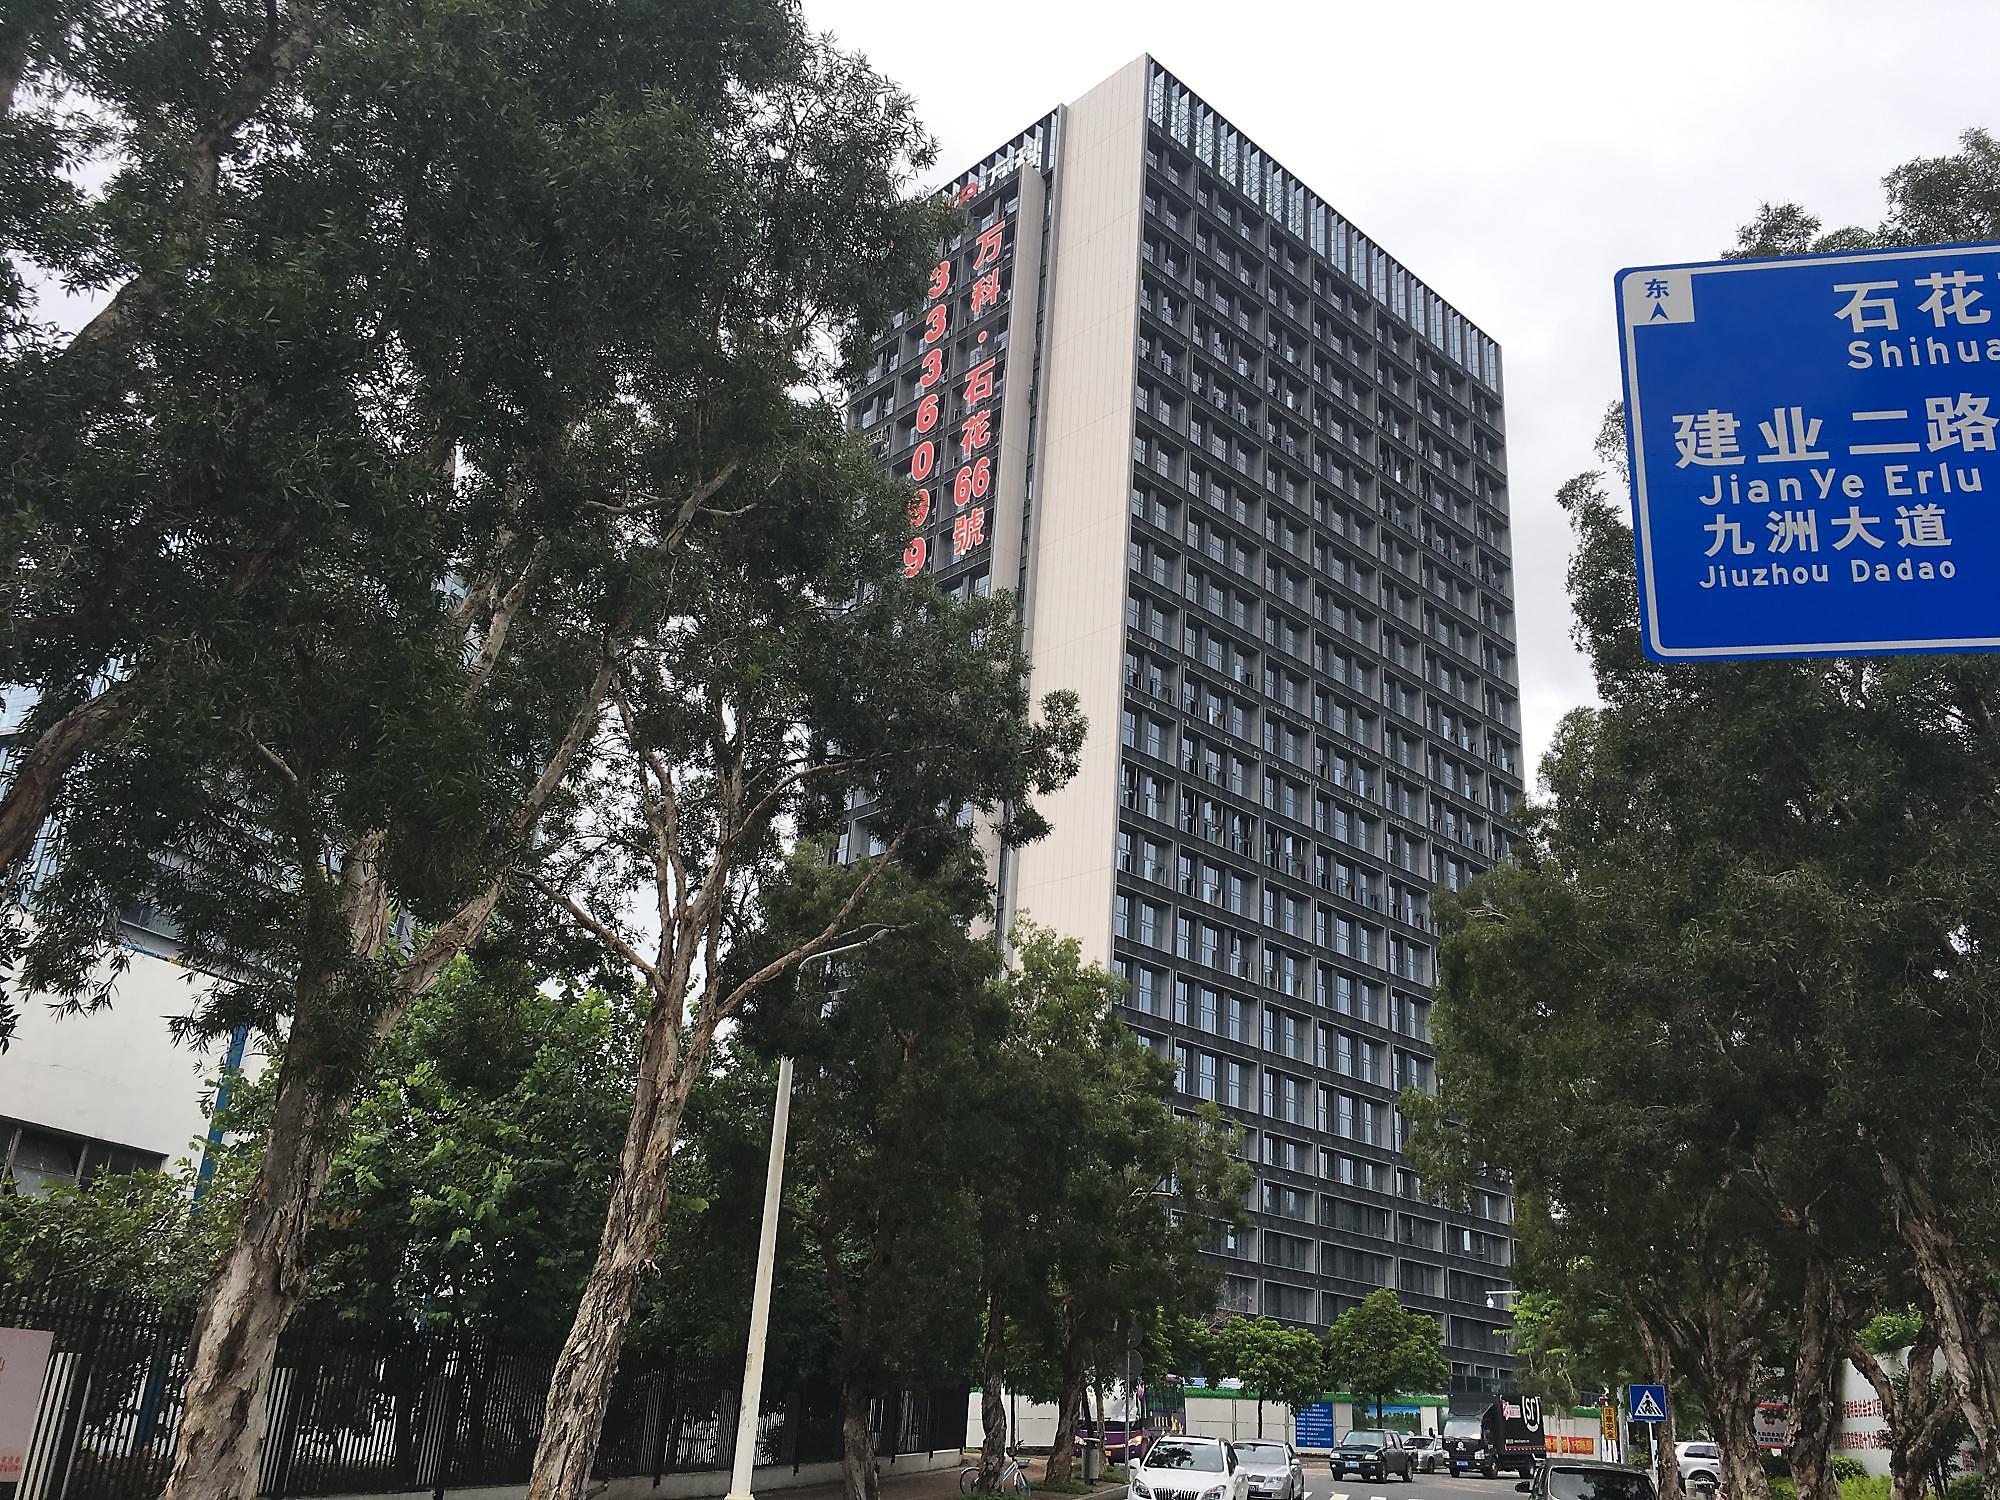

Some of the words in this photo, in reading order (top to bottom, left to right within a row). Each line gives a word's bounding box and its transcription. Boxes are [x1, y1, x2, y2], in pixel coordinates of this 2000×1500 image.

[1644, 278, 1669, 299] 东
[1832, 270, 2000, 333] 石花
[1672, 392, 1999, 469] 建业二路
[1885, 462, 1983, 497] Erlu
[1703, 503, 1952, 558] 九洲大道
[1699, 561, 1829, 589] Jiuzhou
[1851, 558, 1957, 583] Dadao
